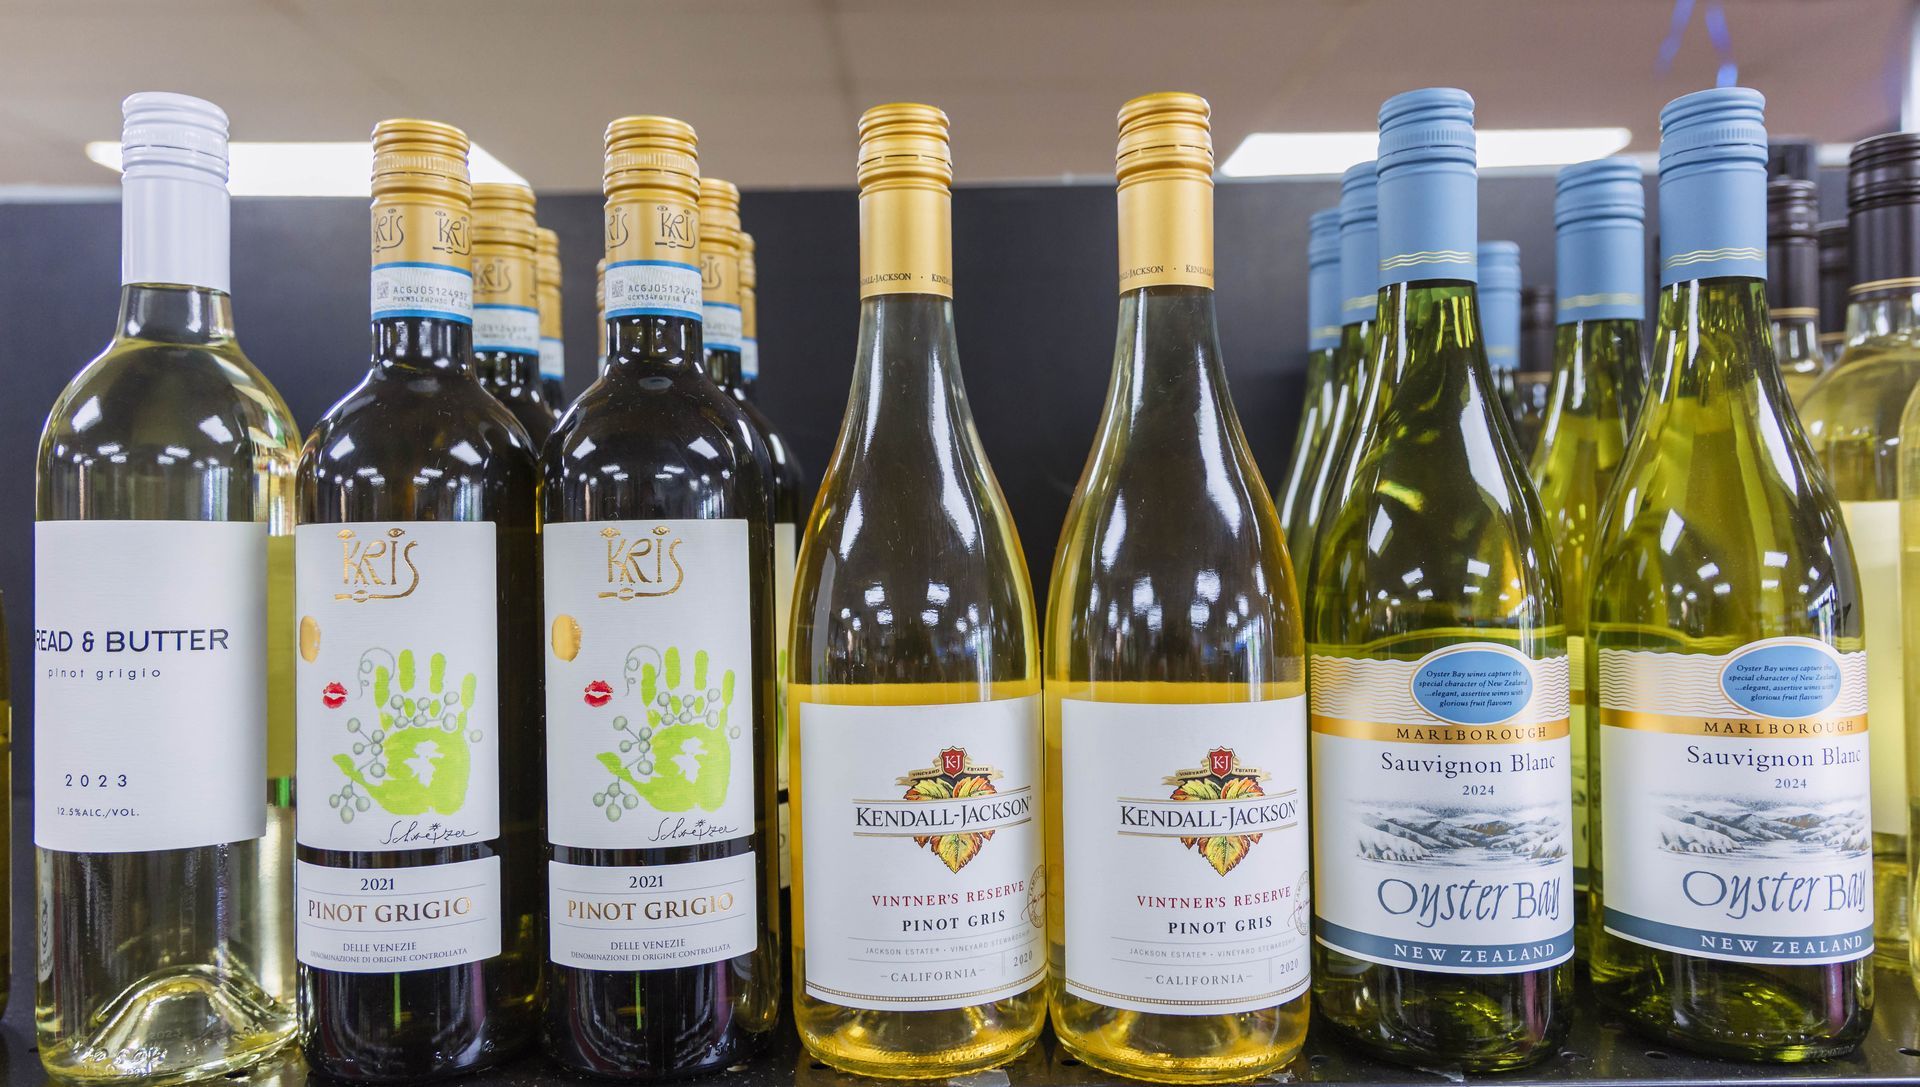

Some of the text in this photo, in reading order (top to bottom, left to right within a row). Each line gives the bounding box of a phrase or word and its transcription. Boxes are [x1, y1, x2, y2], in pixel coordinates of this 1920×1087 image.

[654, 212, 697, 250] KRIS
[335, 540, 419, 602] KRIS
[598, 538, 683, 600] KRIS
[82, 630, 95, 653] &
[106, 628, 229, 653] BUTTER
[48, 667, 161, 681] pinot grigio
[1426, 670, 1451, 678] Oyster
[1452, 670, 1466, 678] Bay
[1488, 671, 1511, 679] capture
[1737, 664, 1762, 672] Oyster
[1764, 664, 1778, 673] Bay
[1419, 680, 1443, 688] special
[1729, 674, 1755, 683] special
[1440, 699, 1469, 708] glorious
[1470, 699, 1485, 708] fruit
[1751, 693, 1782, 702] glorious
[1397, 727, 1547, 741] MARLBOROUGH
[1704, 721, 1854, 735] MARLBOROUGH
[1381, 752, 1556, 779] Sauvignon Blanc
[1687, 745, 1862, 772] Sauvignon Blanc
[64, 773, 128, 788] 2023
[1774, 778, 1808, 789] 2024
[1462, 784, 1495, 796] 2024
[360, 878, 395, 891] 2021
[628, 874, 664, 889] 2021
[872, 880, 1024, 907] VINTNER'S RESERVE
[1136, 886, 1291, 909] VINTNER'S RESERVE
[1682, 870, 1867, 919] Oyster Bay
[308, 896, 472, 923] PINOT GRIGIO
[567, 892, 735, 921] PINOT GRIGIO
[1377, 876, 1560, 928] Oyster Bay
[902, 910, 1006, 932] PINOT GRIS
[1168, 915, 1273, 935] PINOT GRIS
[342, 941, 417, 952] DELLE VENEZIE
[571, 951, 629, 962] DENOMINAZIONE
[642, 952, 677, 961] ORIGINE
[678, 943, 731, 959] CONTROLLATA
[610, 938, 686, 951] DELLE VENEZIE
[1700, 935, 1863, 954] NEW ZEALAND
[372, 956, 407, 964] ORIGINE
[409, 947, 468, 962] CONTROLLATA
[1013, 950, 1034, 967] 2020
[1393, 943, 1556, 963] NEW ZEALAND
[1279, 958, 1299, 974] 2020
[890, 967, 978, 982] CALIFORNIA
[1156, 974, 1245, 986] CALIFORNIA
